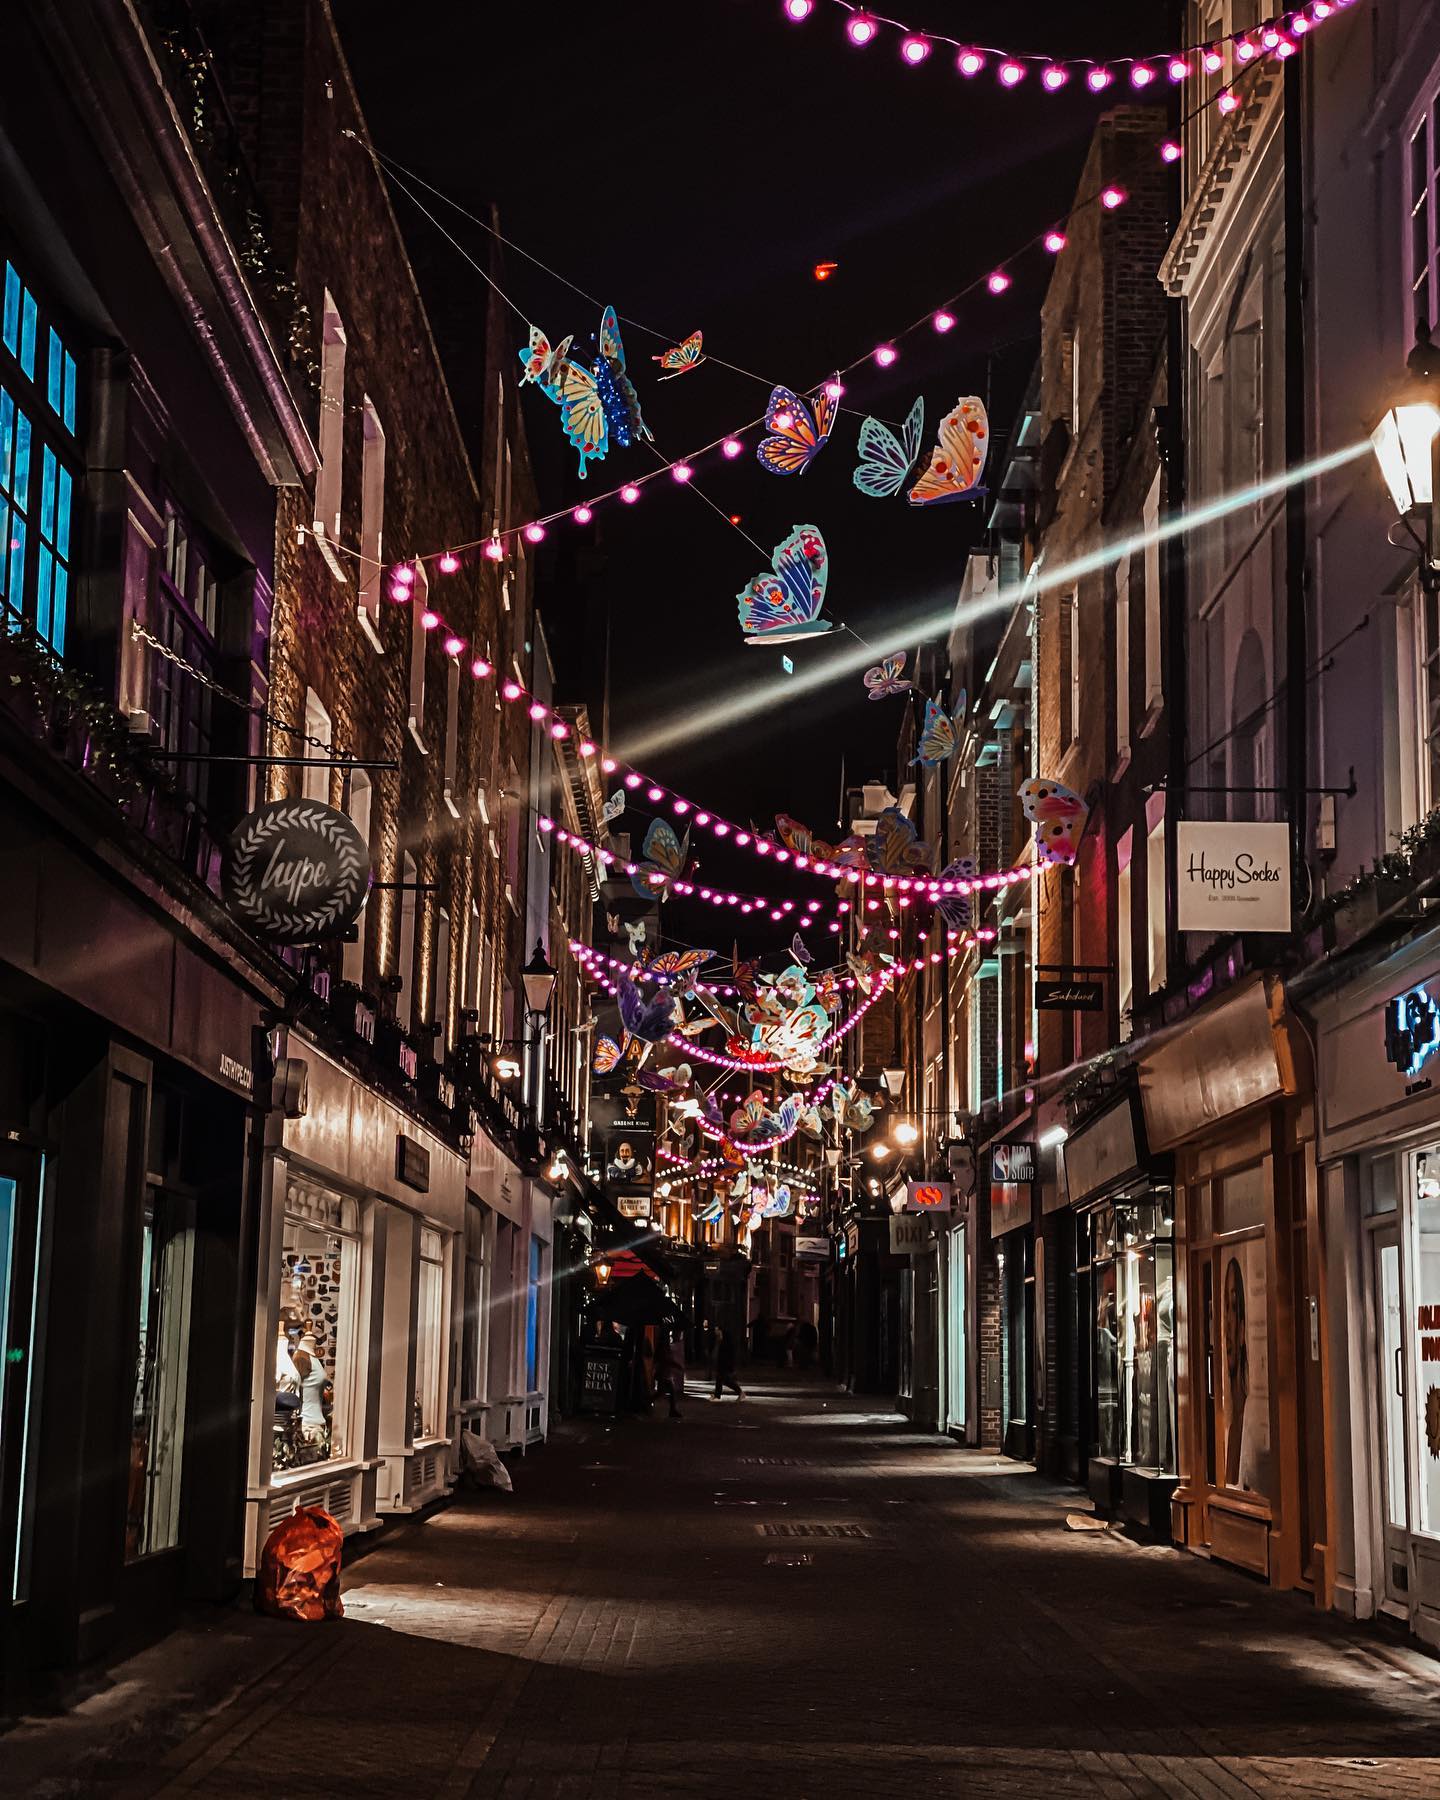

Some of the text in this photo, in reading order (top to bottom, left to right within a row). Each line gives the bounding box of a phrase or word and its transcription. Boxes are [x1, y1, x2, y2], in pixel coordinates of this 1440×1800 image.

[1186, 851, 1280, 890] Happy Socks
[1011, 1145, 1032, 1164] NBA
[1011, 1165, 1034, 1180] Store
[895, 1226, 922, 1247] pixi
